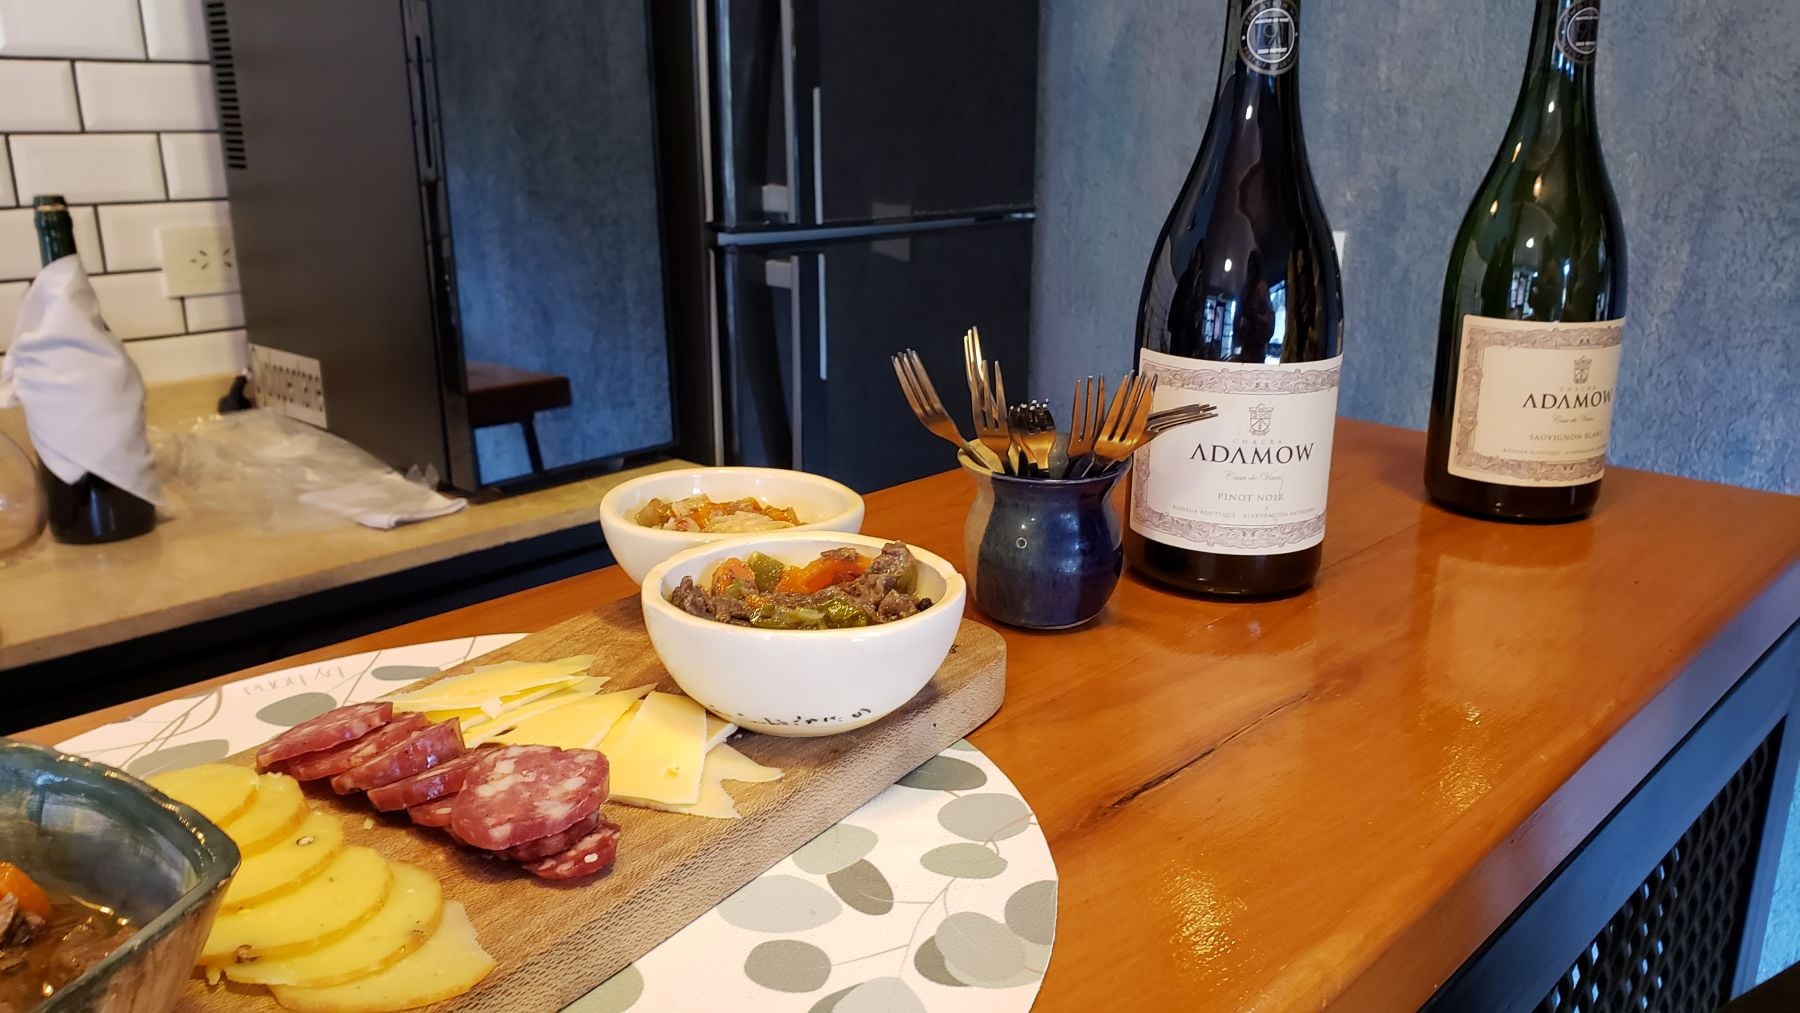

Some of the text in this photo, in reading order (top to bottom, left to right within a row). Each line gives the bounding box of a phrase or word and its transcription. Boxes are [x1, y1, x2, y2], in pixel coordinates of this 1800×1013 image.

[1529, 433, 1582, 442] SAUVIGNON
[1189, 443, 1315, 465] ADAMOW
[1218, 492, 1285, 502] PINOT NOIR
